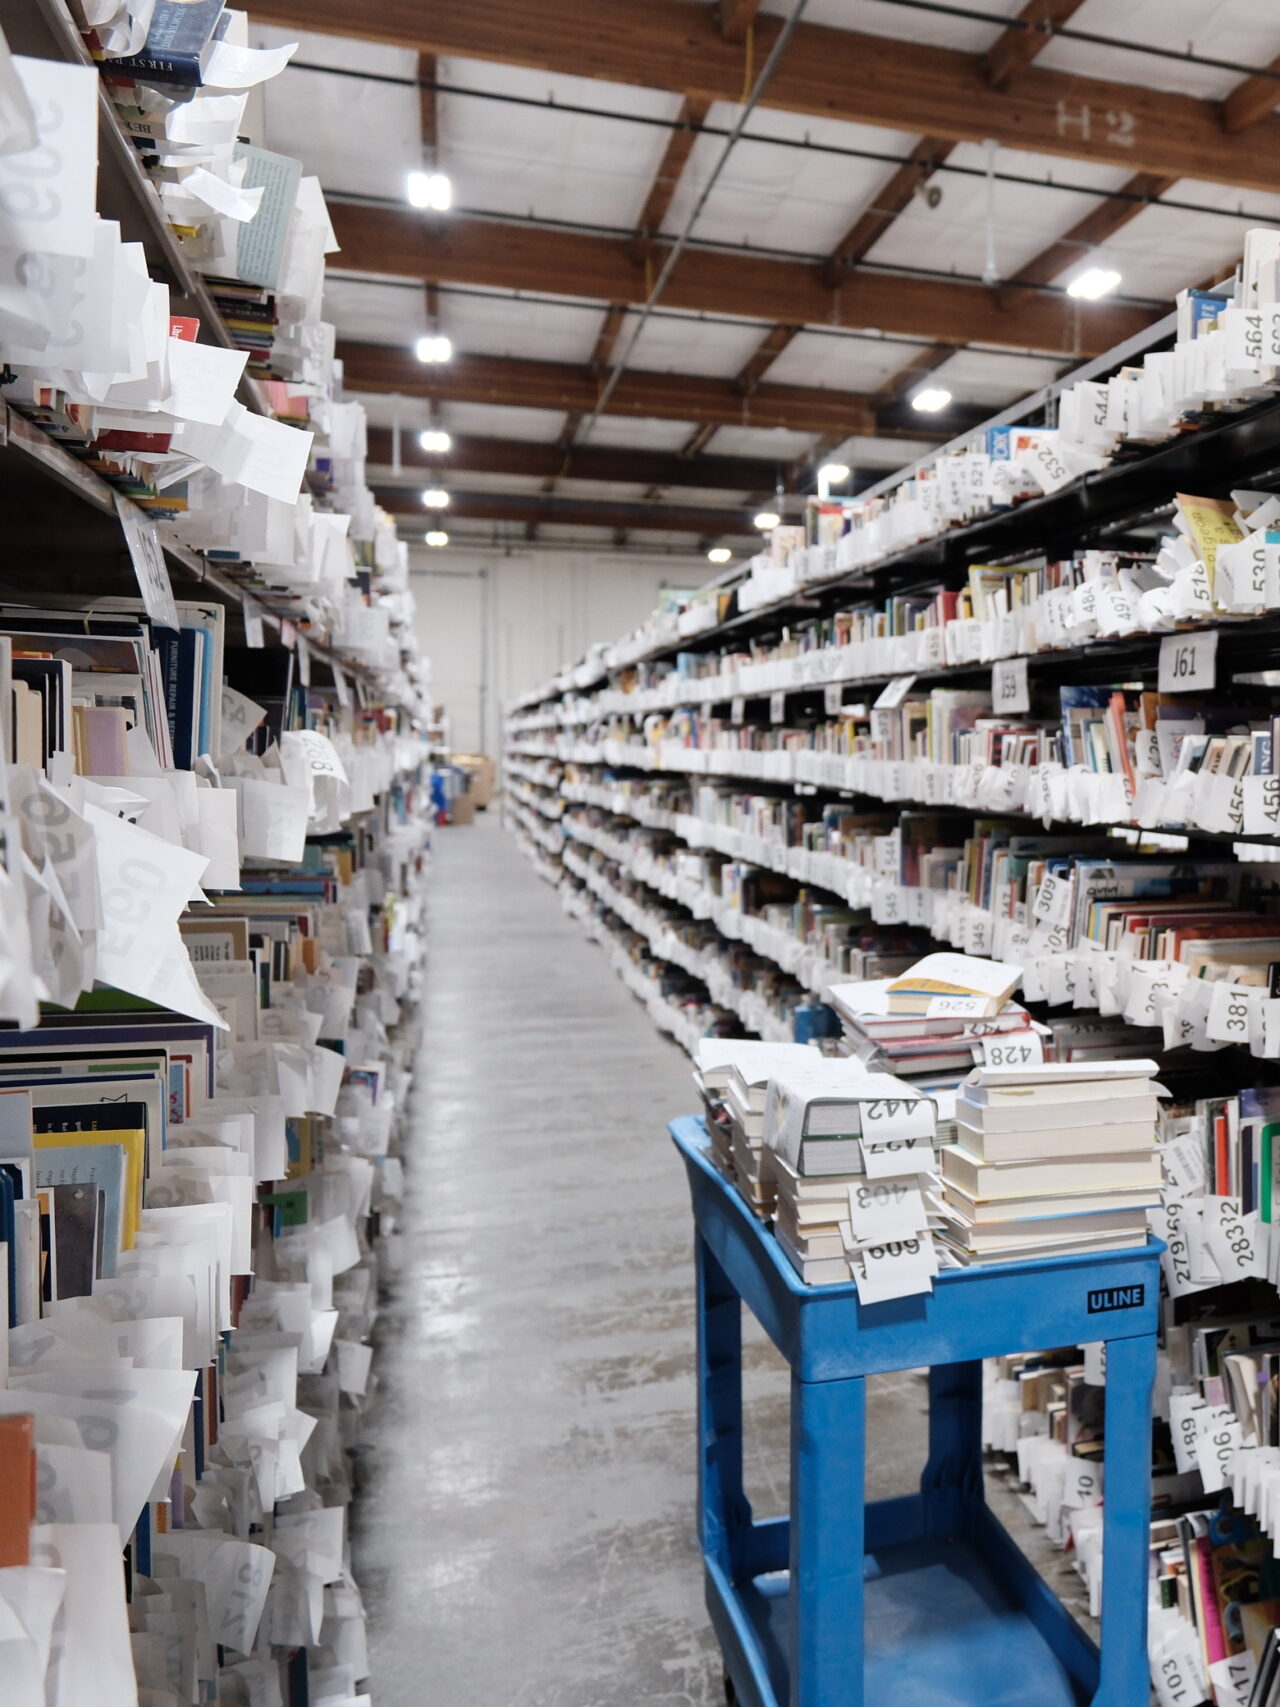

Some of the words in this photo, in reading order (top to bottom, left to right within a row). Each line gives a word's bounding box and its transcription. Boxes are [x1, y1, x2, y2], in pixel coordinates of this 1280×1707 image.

[130, 57, 174, 72] FIRST
[1245, 314, 1263, 369] 564
[169, 640, 179, 681] FURNITURE
[1173, 646, 1197, 678] J61
[168, 683, 177, 710] REPAIR
[1264, 778, 1280, 824] 456
[1038, 877, 1057, 912] 309
[972, 921, 986, 949] 345
[937, 998, 976, 1014] 526
[1226, 991, 1249, 1032] 381
[990, 1044, 1032, 1067] 428
[866, 1099, 919, 1121] 442
[856, 1184, 908, 1210] 403
[1091, 1288, 1142, 1311] ULINE
[1161, 1658, 1186, 1703] 103
